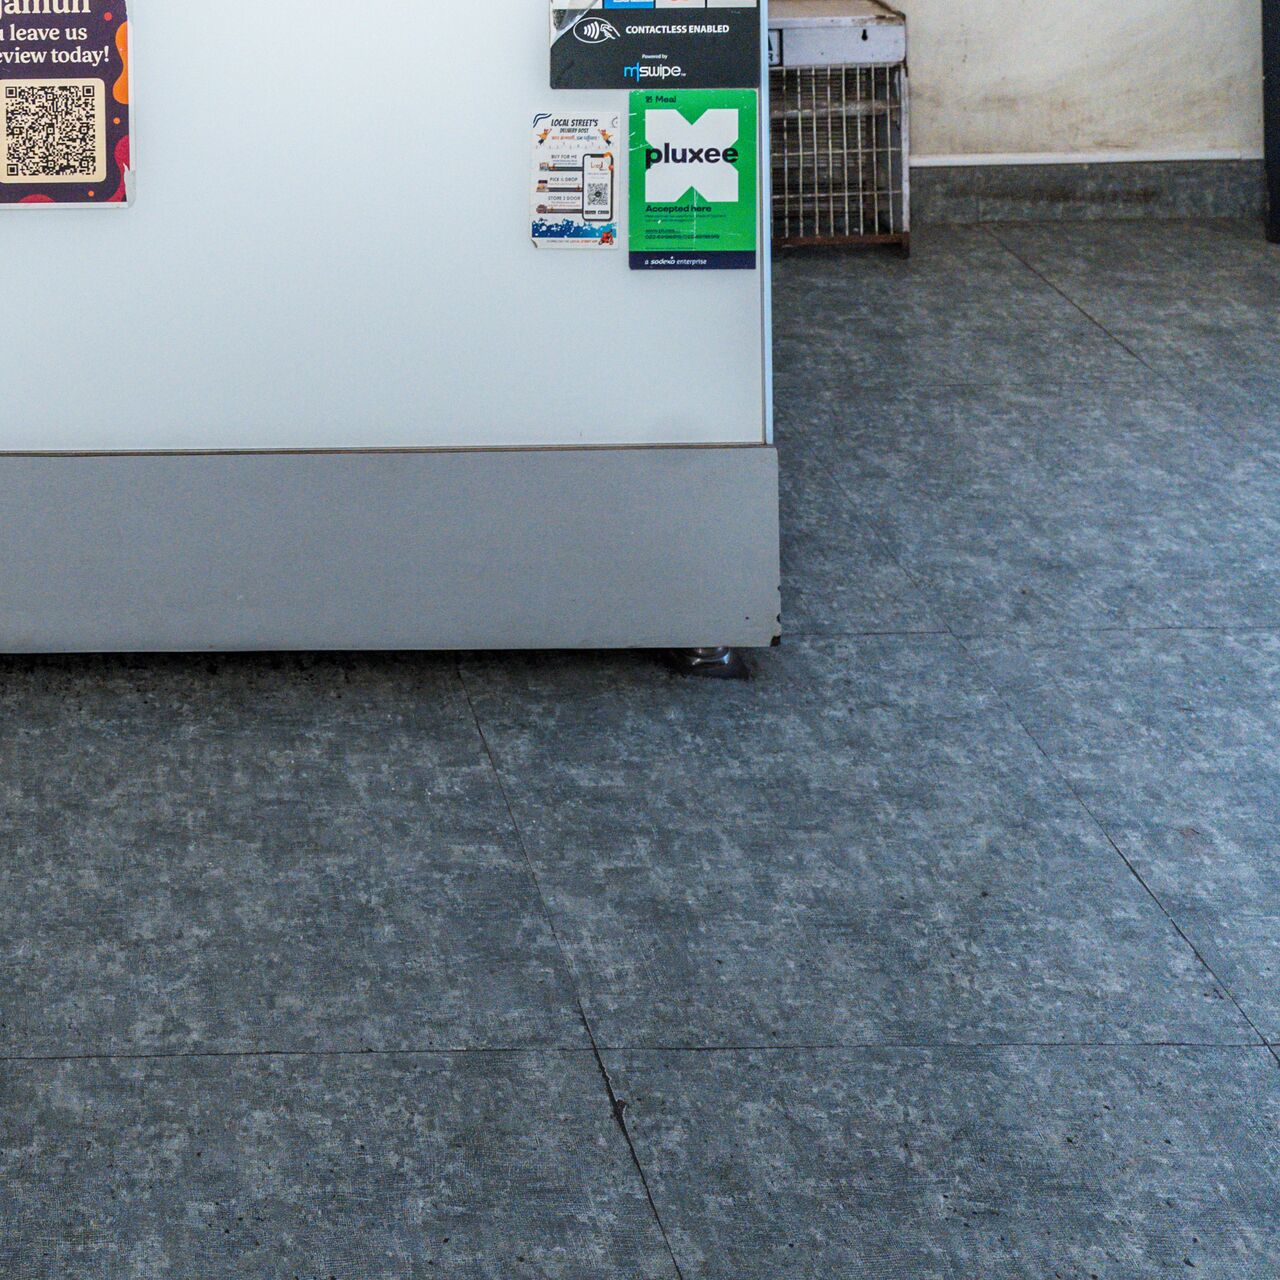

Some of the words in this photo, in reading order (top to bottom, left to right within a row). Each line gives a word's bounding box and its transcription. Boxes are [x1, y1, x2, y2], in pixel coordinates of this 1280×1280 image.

[10, 24, 60, 41] leave
[65, 27, 88, 41] us
[625, 25, 687, 34] CONTACTLESS
[689, 25, 730, 33] ENABLED
[51, 46, 109, 67] today!
[551, 119, 569, 127] LOCAL
[570, 119, 599, 127] STREET'S
[645, 143, 739, 170] pluxee
[645, 205, 689, 213] Accepted
[650, 256, 675, 265] sodexo
